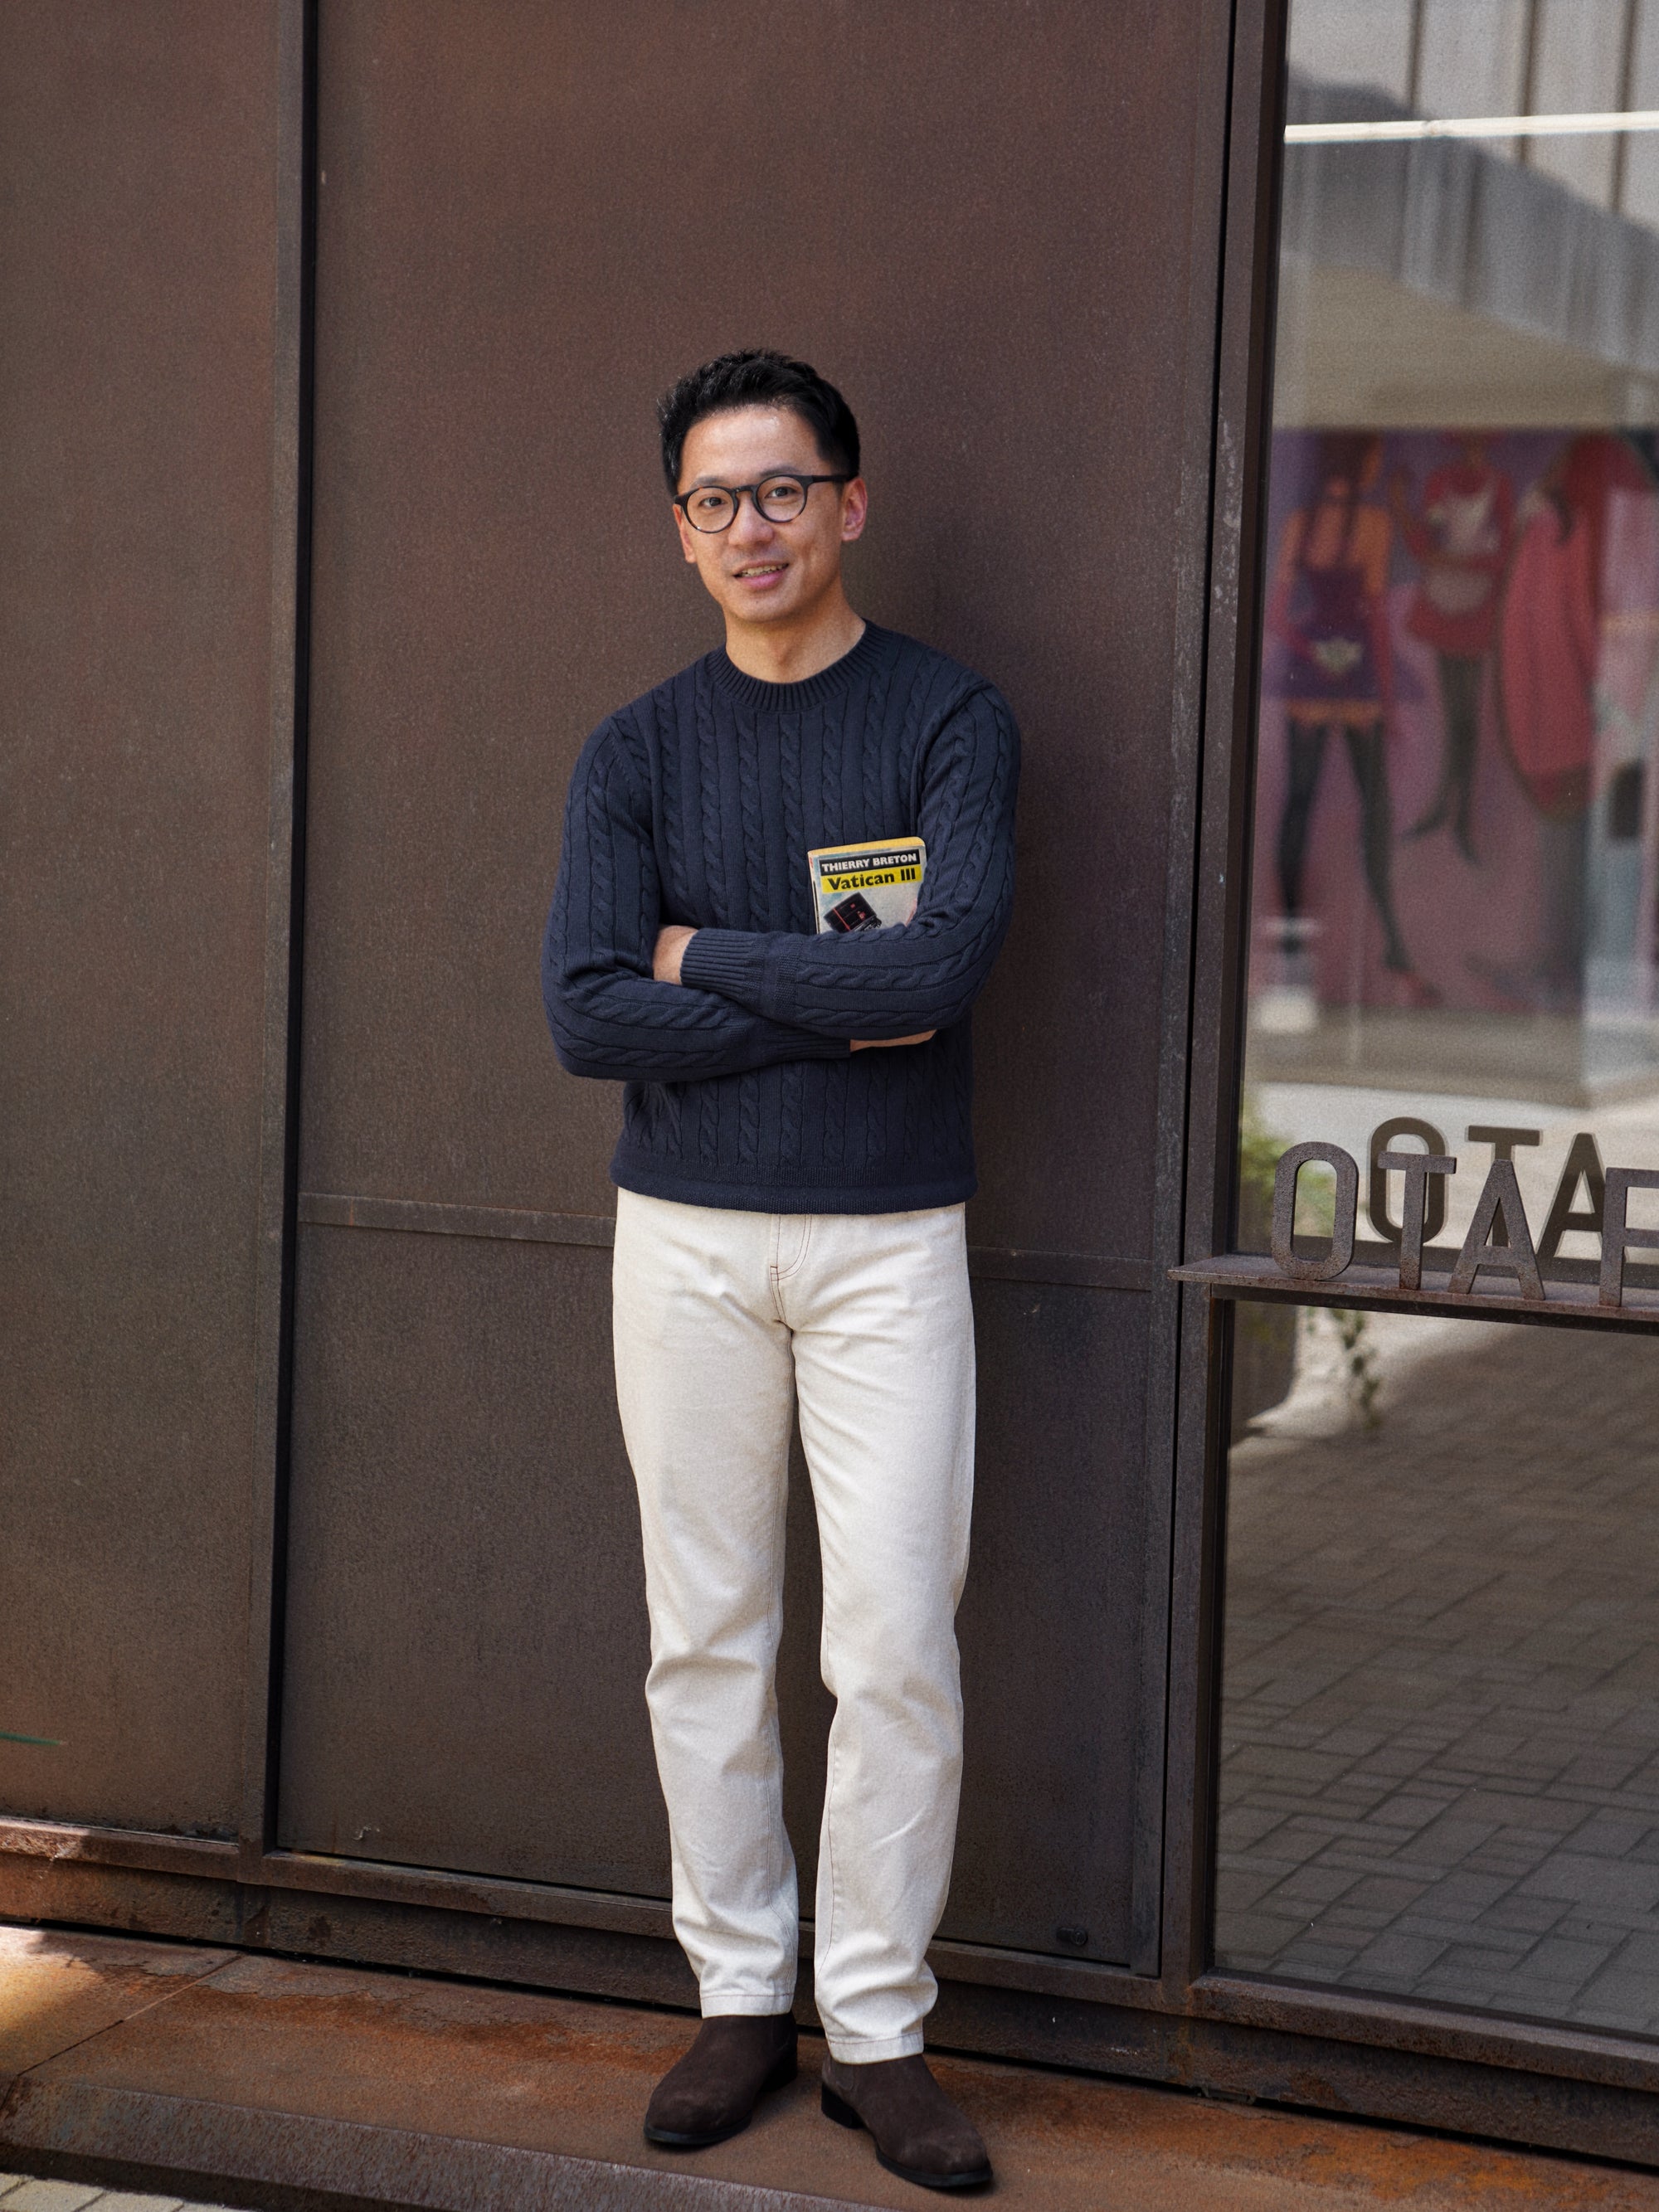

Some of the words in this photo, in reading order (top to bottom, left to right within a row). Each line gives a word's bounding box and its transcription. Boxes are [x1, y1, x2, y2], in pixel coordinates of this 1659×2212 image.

[822, 858, 869, 872] THIERRY
[873, 853, 917, 866] BRETON
[828, 873, 895, 890] Vatican
[900, 868, 916, 881] III
